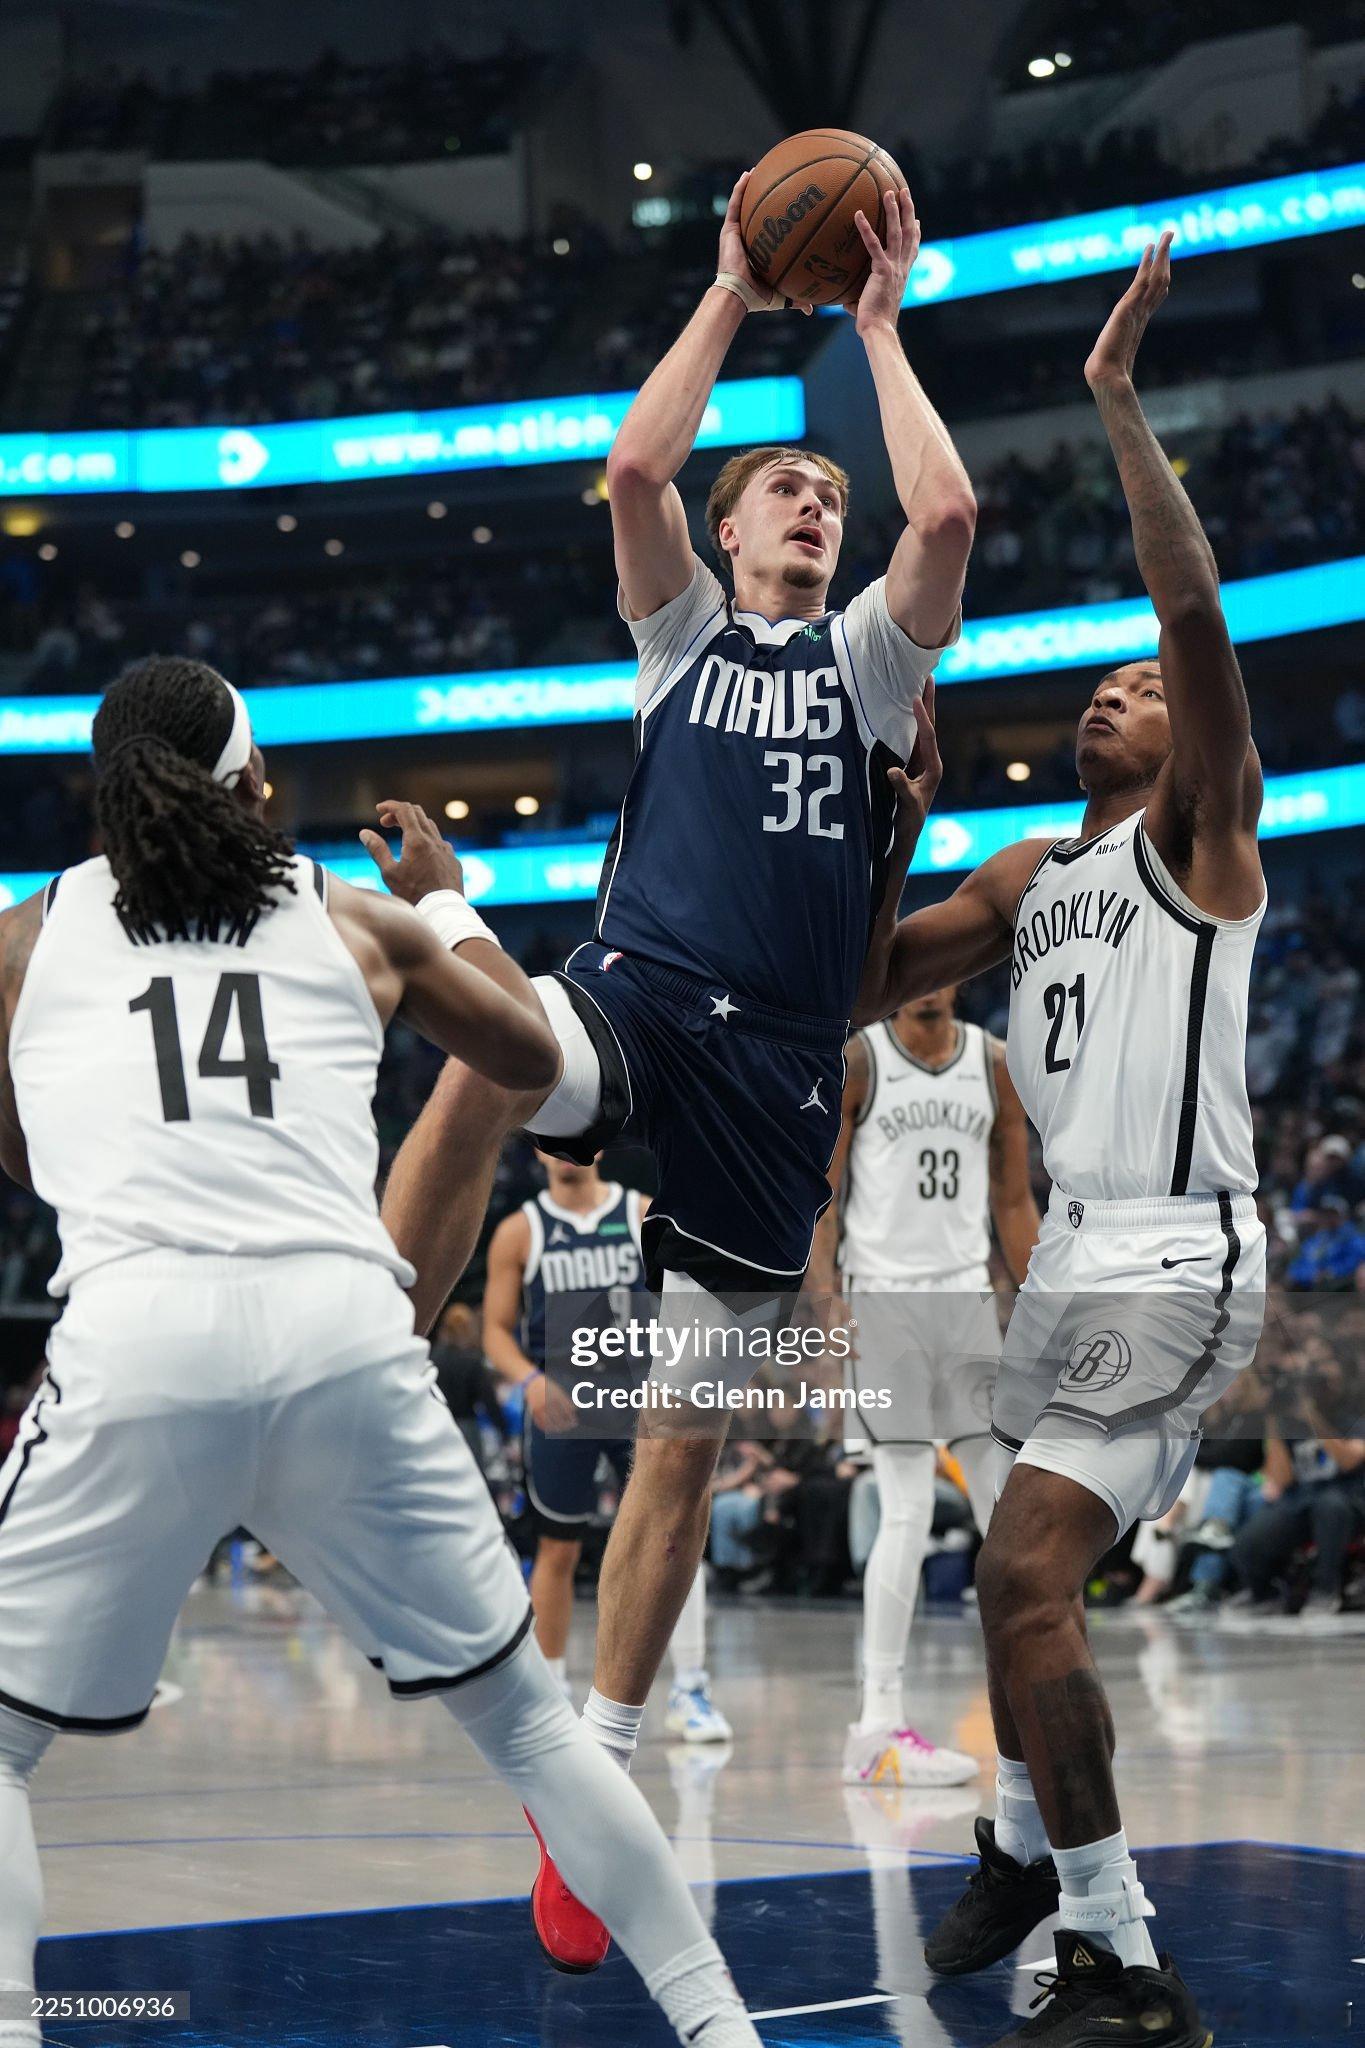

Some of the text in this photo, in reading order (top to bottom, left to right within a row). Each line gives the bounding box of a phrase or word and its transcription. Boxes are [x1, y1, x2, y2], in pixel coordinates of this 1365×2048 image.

[750, 184, 827, 274] Wilson
[762, 750, 845, 840] 32
[1010, 889, 1140, 991] BROOKLYN
[128, 972, 281, 1122] 14
[1043, 972, 1085, 1075] 21
[877, 1099, 987, 1142] BROOKLYN
[919, 1149, 960, 1200] 33
[1068, 1339, 1111, 1383] B
